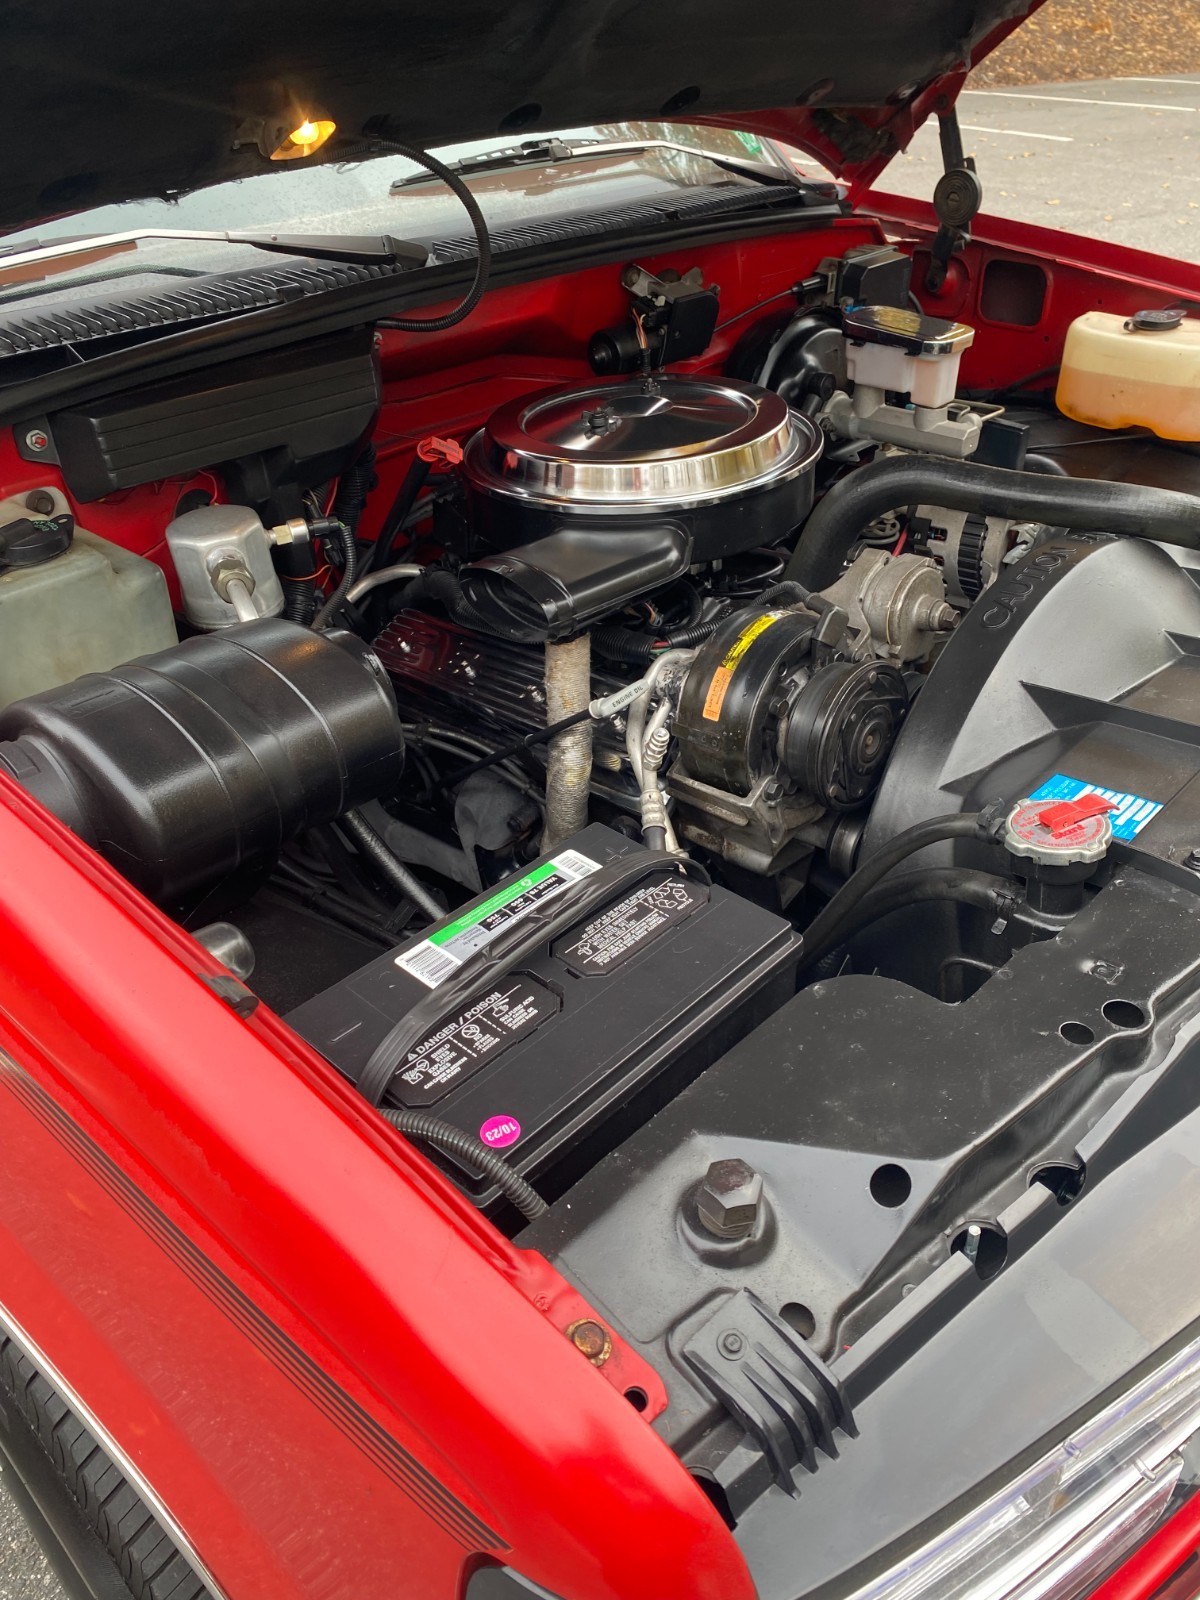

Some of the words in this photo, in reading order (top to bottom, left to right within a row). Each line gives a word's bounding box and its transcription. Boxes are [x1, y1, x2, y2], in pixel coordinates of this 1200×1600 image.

[981, 546, 1077, 629] CAUTION
[612, 691, 633, 708] ENGINE
[634, 685, 644, 694] OIL
[538, 876, 558, 890] VALUE
[415, 1022, 459, 1054] DANGER
[463, 991, 502, 1018] POISON
[430, 1043, 450, 1058] SHIELD
[434, 1050, 450, 1061] EYES
[427, 1051, 457, 1073] EXPLOSIVE
[431, 1062, 451, 1076] GASES
[485, 1122, 517, 1142] 10/23
